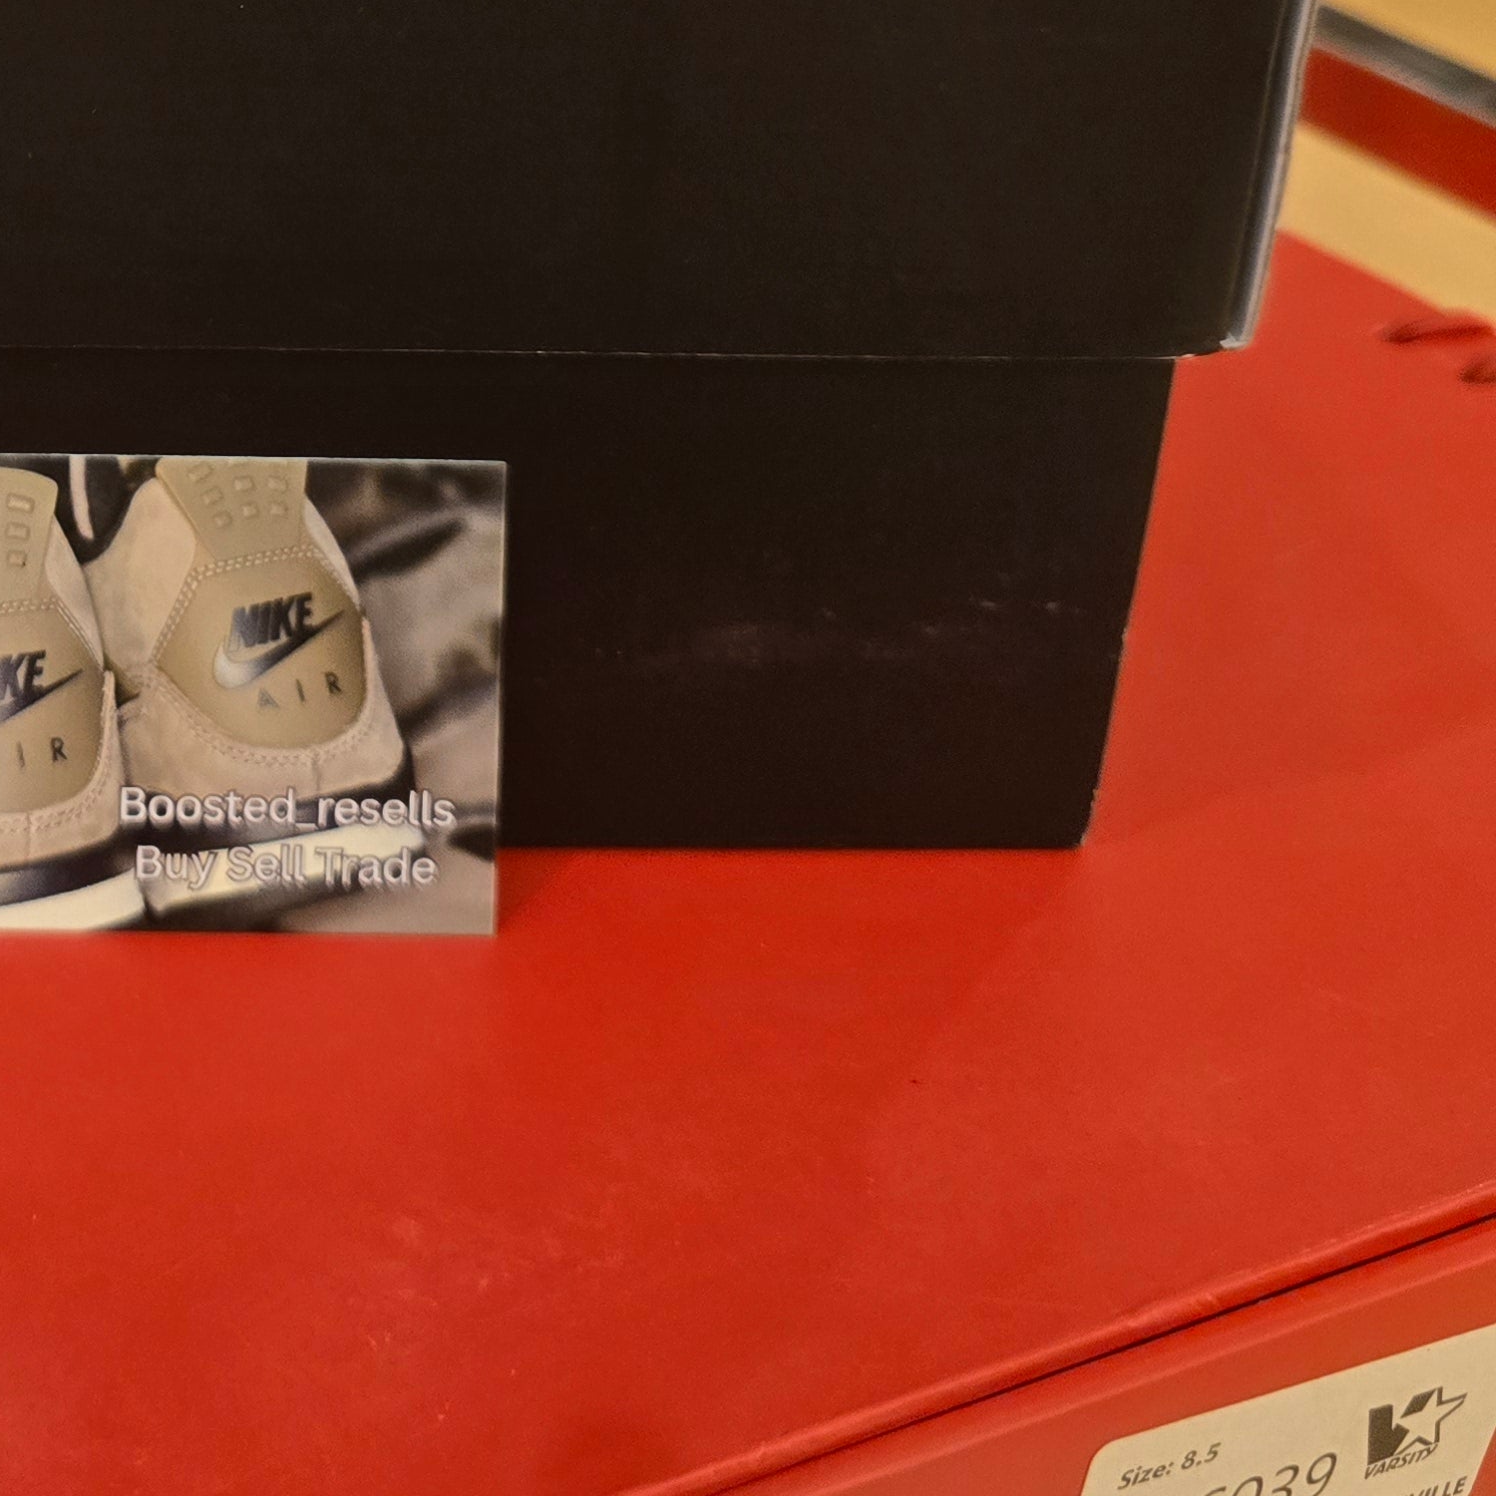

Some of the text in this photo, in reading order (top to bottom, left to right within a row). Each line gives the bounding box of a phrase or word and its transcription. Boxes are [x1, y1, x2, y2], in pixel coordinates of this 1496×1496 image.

[227, 592, 313, 658] NIKE
[257, 670, 342, 709] AIR
[119, 785, 457, 831] Boosted_resells
[134, 843, 439, 890] Buy Sell Trade
[1117, 1442, 1222, 1490] Size: 8.5
[1364, 1443, 1439, 1480] VARSITY
